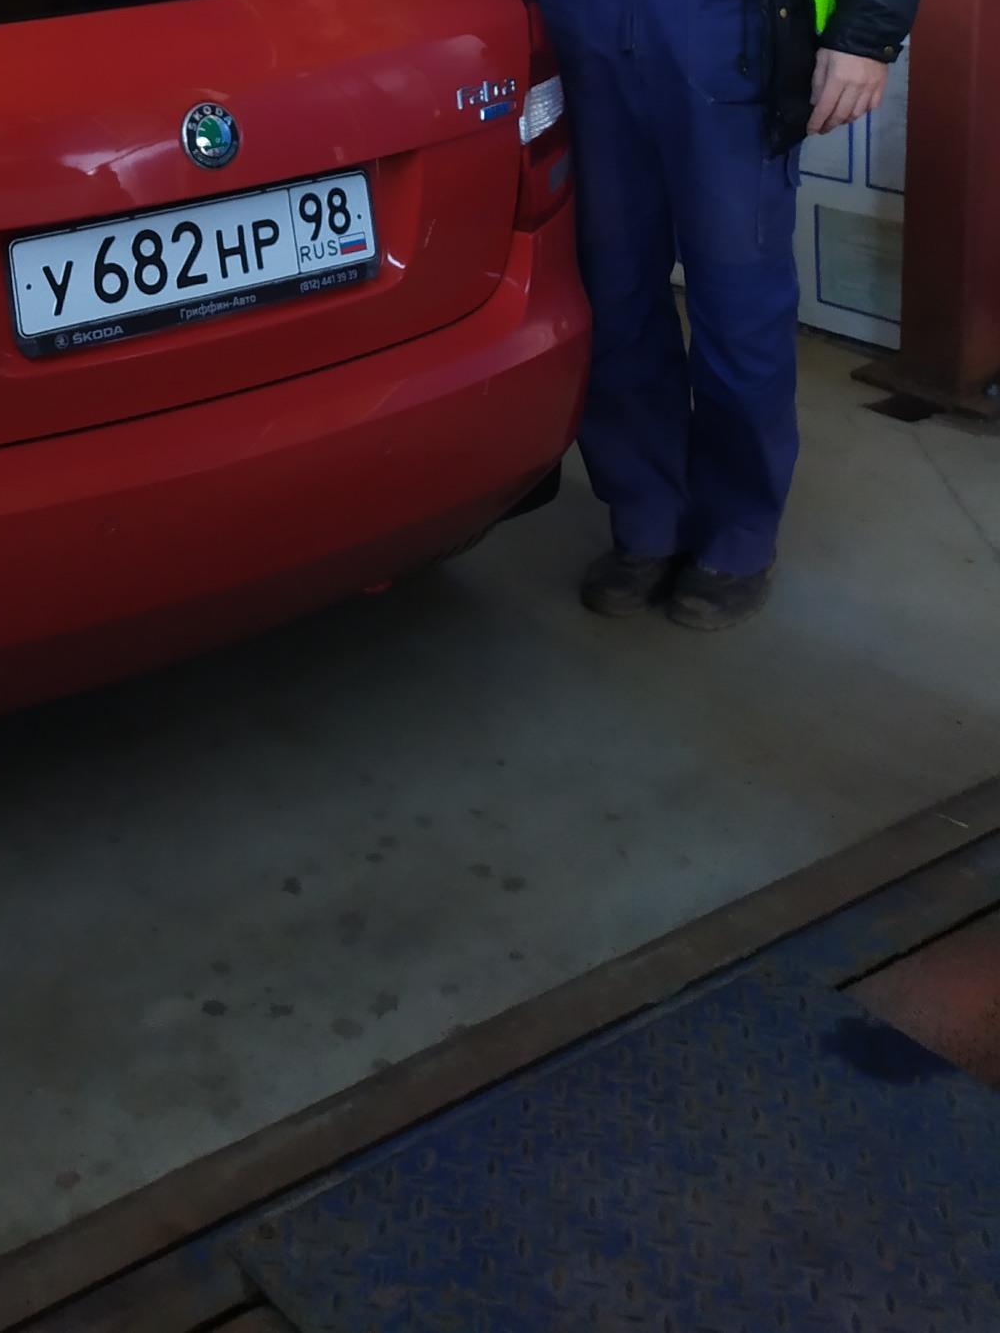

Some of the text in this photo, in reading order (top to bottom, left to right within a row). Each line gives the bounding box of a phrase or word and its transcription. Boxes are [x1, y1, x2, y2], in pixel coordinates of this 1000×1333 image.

[299, 187, 351, 241] 98
[300, 240, 338, 263] RUS
[180, 294, 257, 320] Гриффин-Авто
